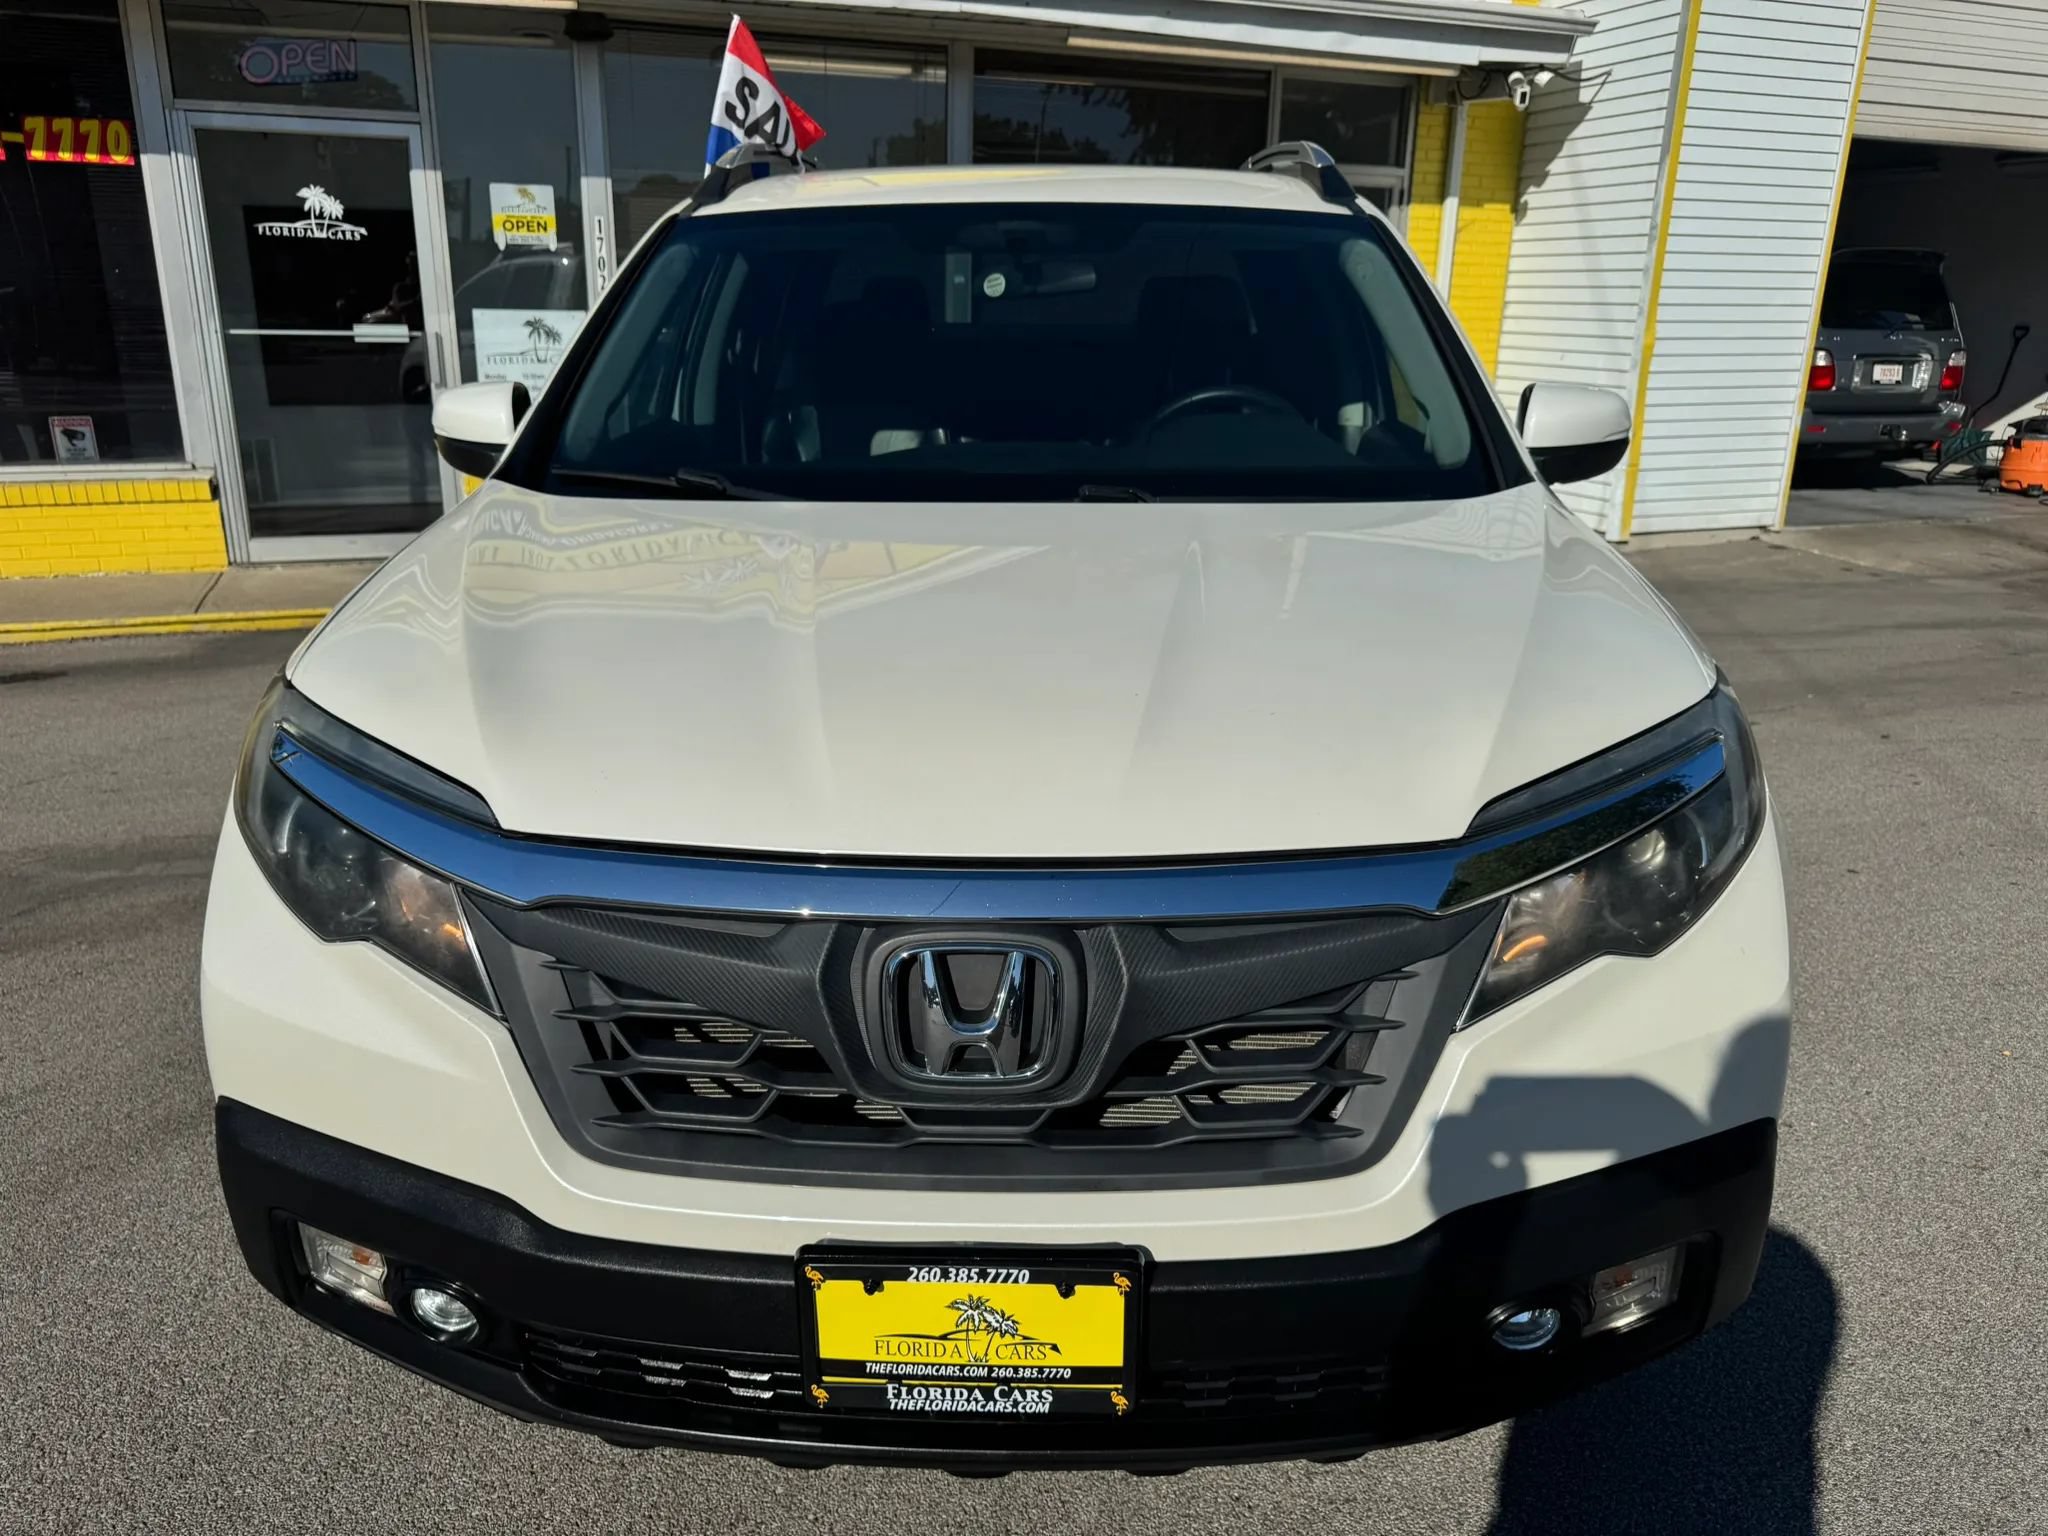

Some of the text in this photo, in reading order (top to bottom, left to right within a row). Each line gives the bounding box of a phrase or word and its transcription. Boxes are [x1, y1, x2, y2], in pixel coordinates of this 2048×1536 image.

[240, 40, 357, 83] OPEN
[258, 225, 361, 241] FLORIDA CARS
[502, 219, 548, 233] OPEN
[906, 1266, 1030, 1284] 260.385.7770
[874, 1339, 1048, 1361] FLORIDA CARS
[865, 1362, 1072, 1380] THEFLORIDACARS.COM 260.385.7770
[889, 1398, 1050, 1414] THEFLORIDACARS.COM
